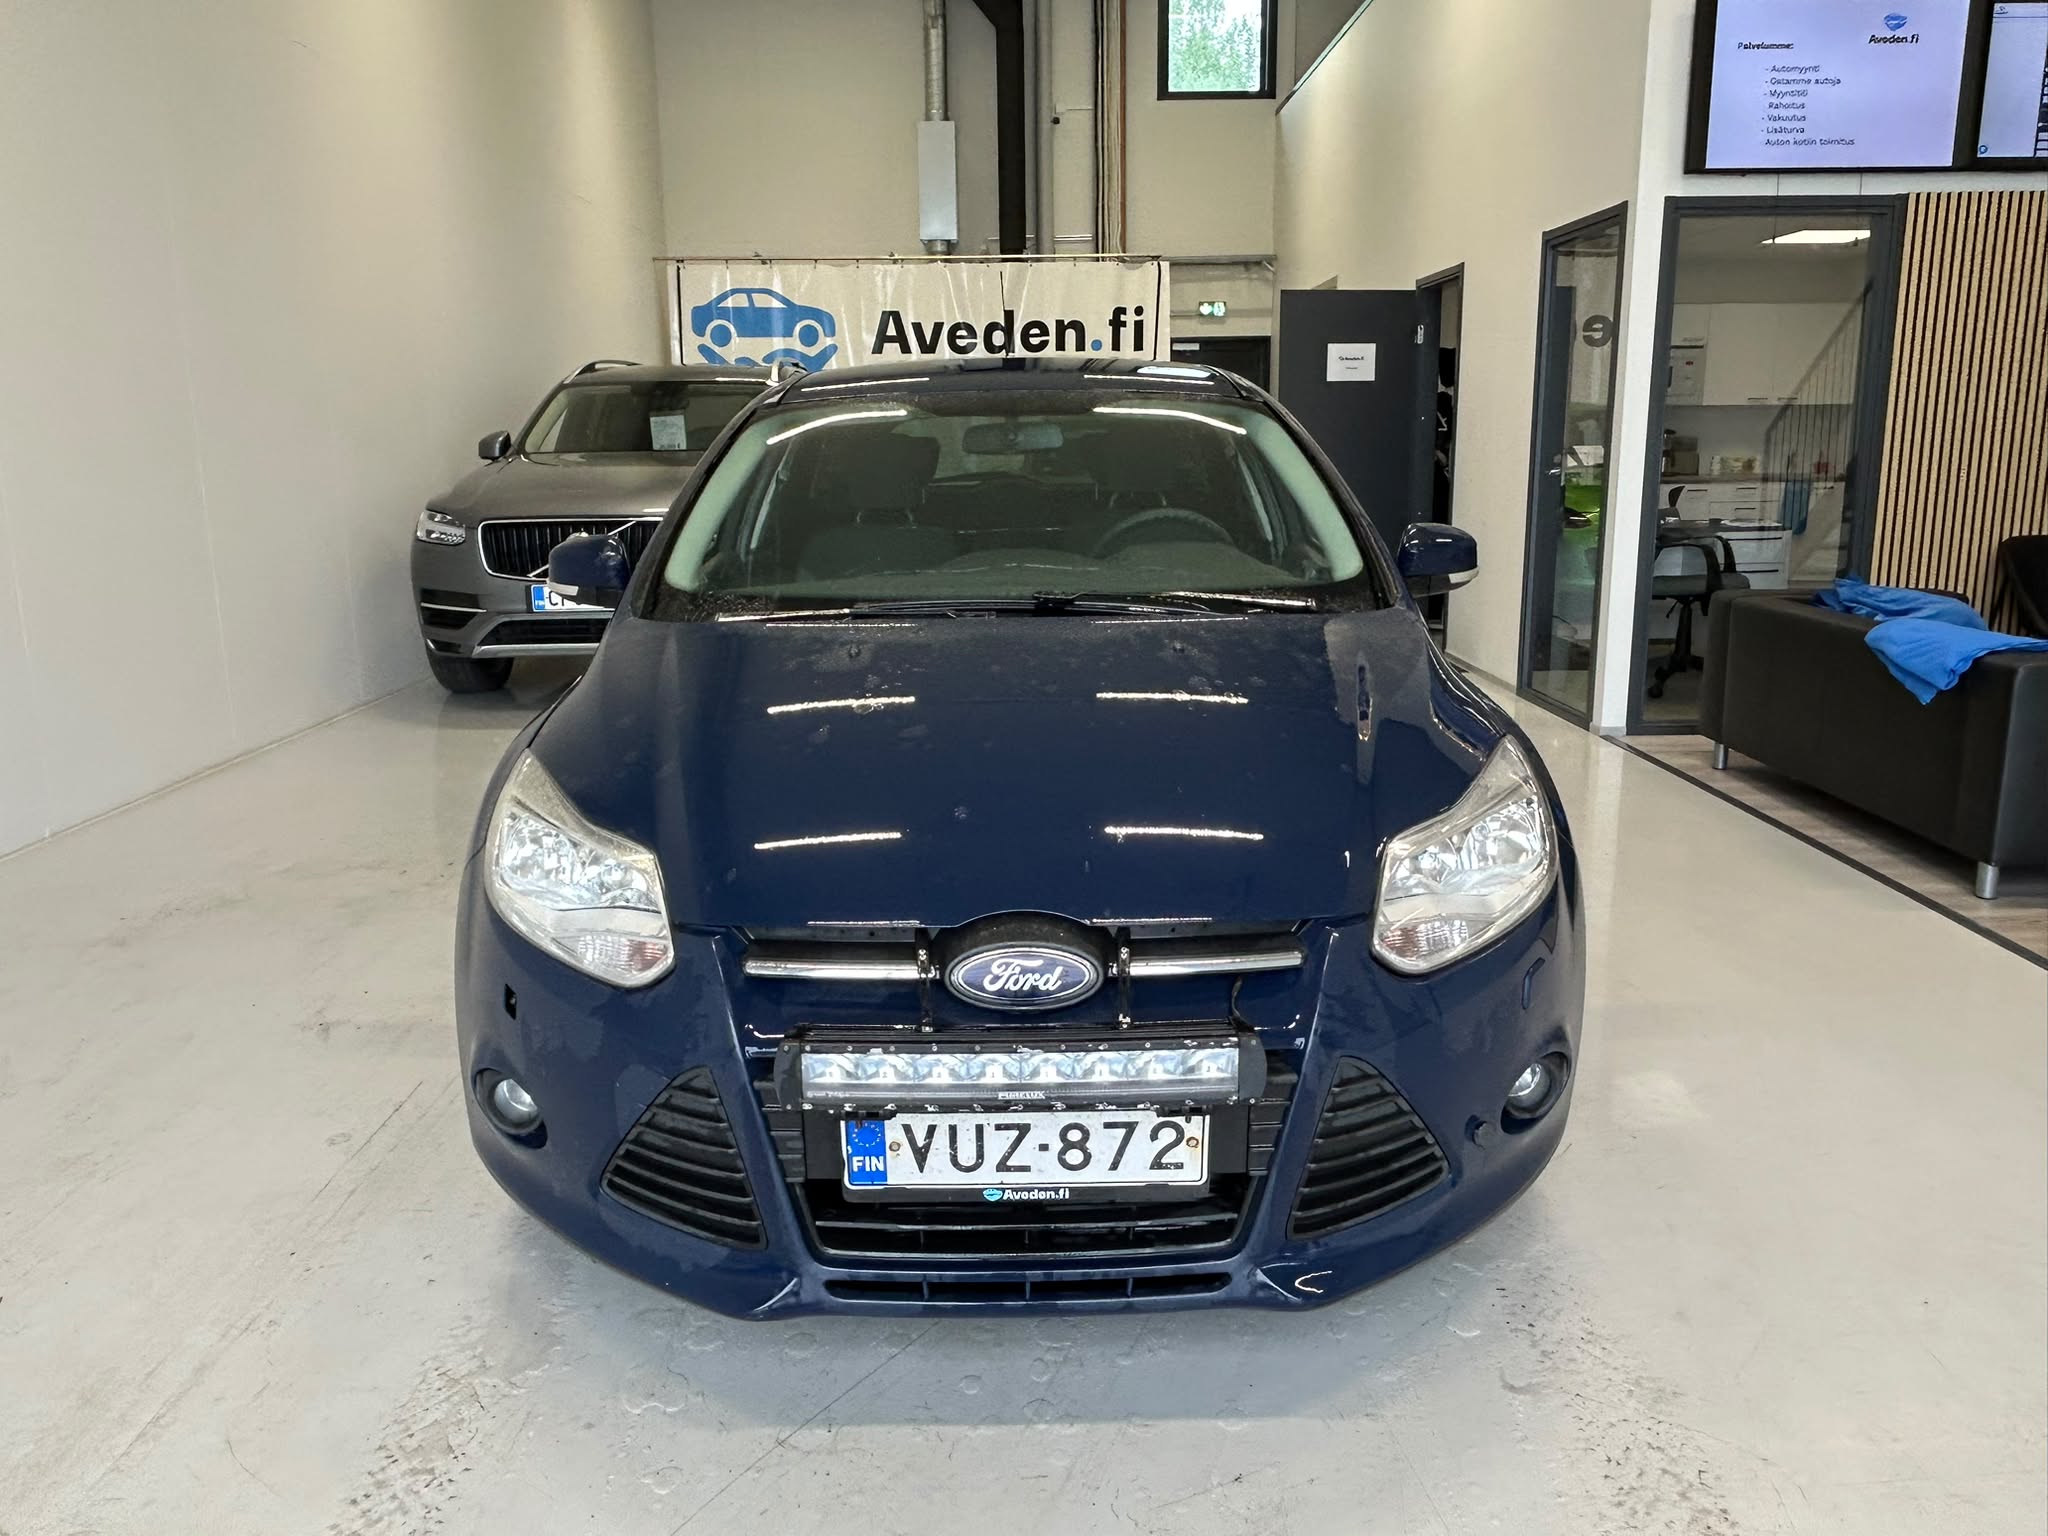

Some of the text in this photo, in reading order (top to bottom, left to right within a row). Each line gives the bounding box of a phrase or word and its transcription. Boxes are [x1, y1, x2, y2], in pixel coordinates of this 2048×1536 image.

[871, 305, 1145, 355] Aveden.fi
[983, 957, 1064, 992] Ford
[852, 1120, 1186, 1174] FIN VUZ-872
